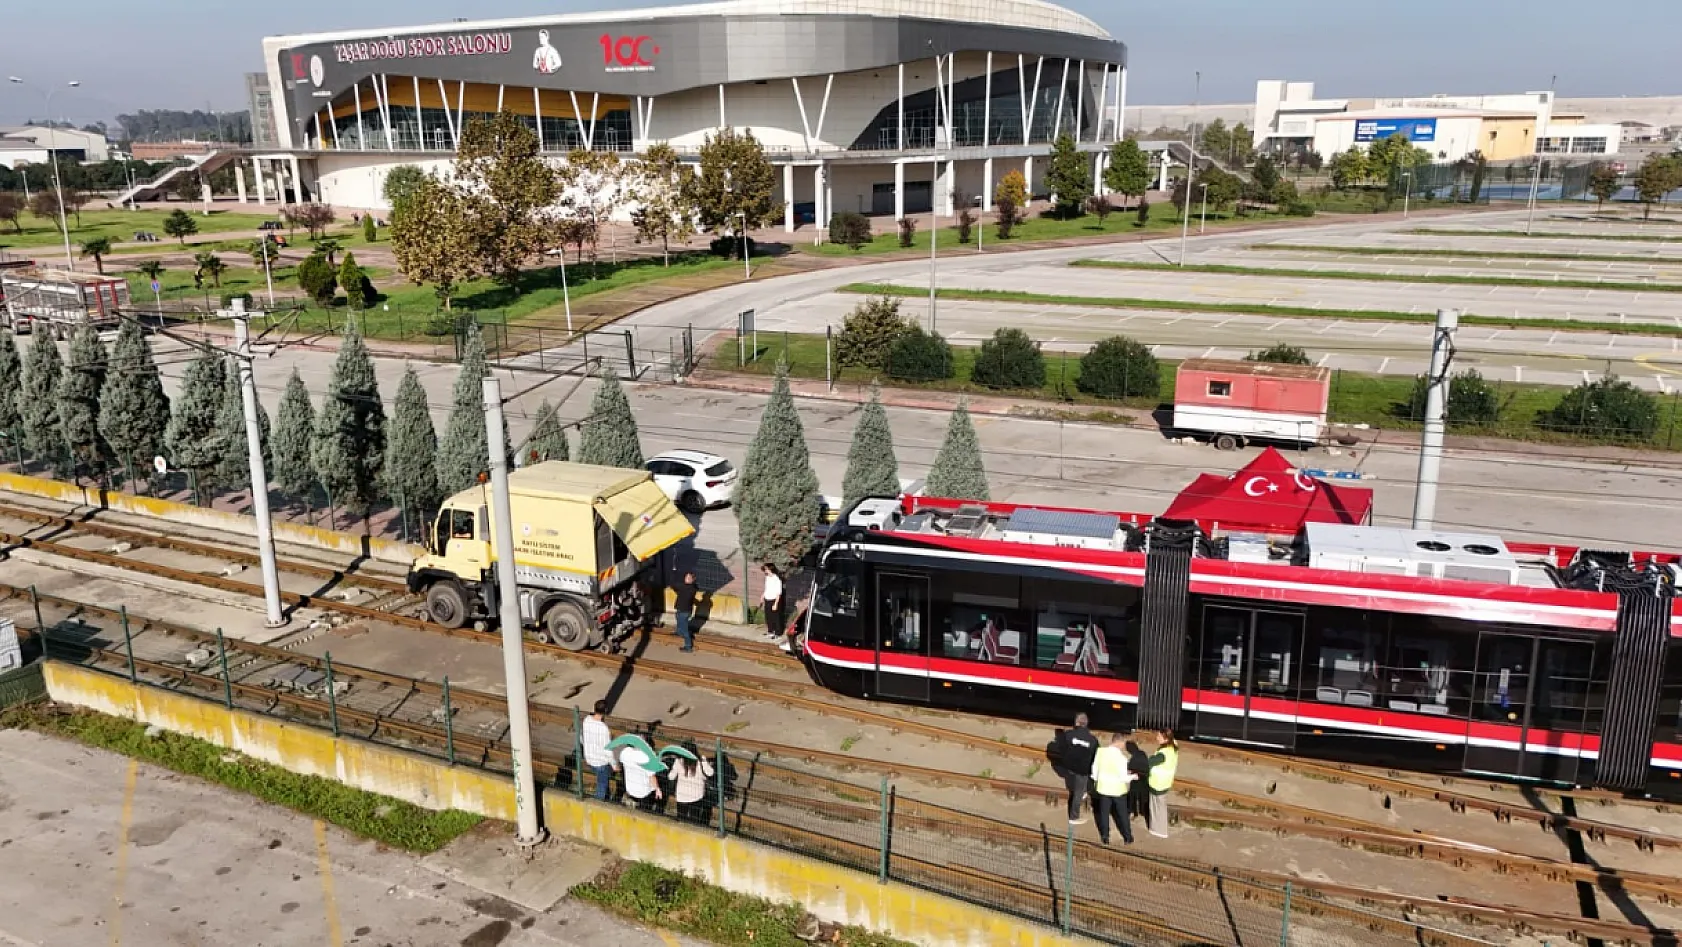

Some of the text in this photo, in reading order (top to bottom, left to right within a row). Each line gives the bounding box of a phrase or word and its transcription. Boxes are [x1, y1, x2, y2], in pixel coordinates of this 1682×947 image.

[333, 43, 369, 64] YAŞAR
[408, 36, 446, 58] SPOR
[447, 33, 512, 55] SALONU
